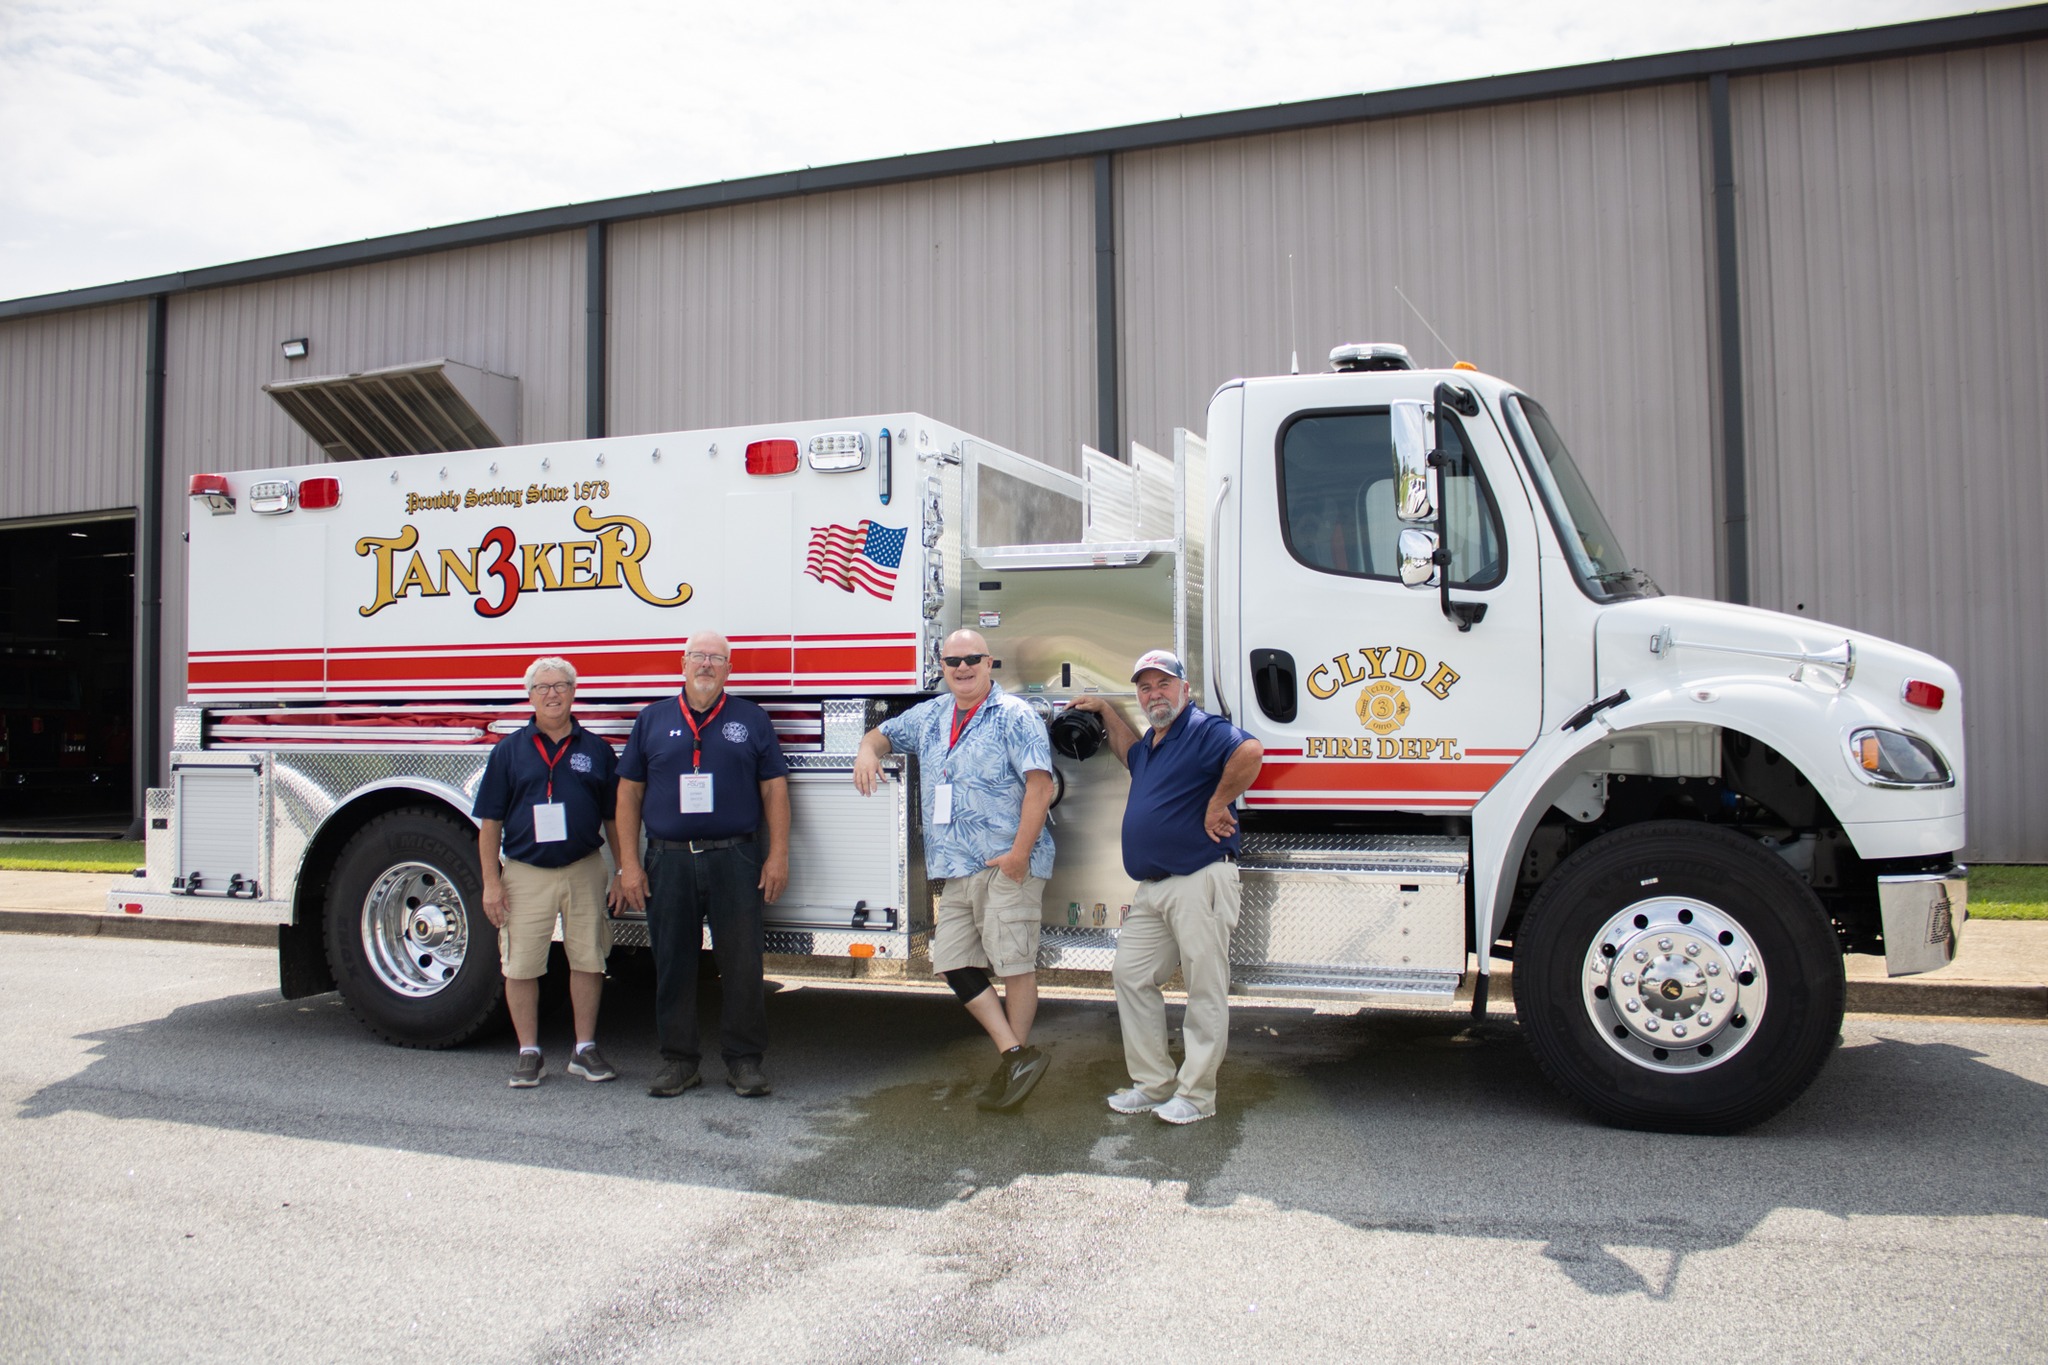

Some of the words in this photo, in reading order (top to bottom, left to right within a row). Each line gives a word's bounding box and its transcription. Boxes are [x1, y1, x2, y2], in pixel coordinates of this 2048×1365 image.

[405, 489, 461, 515] Proudly
[464, 486, 523, 508] Serving
[526, 483, 569, 504] Since
[573, 479, 609, 500] 1873
[1306, 646, 1461, 700] CLYDE
[1370, 684, 1395, 693] CLYDE
[1376, 698, 1390, 717] 3
[1373, 722, 1392, 730] OHIO
[1306, 737, 1372, 760] FIRE
[1377, 737, 1462, 760] DEPT.
[403, 836, 481, 892] MICHELIN
